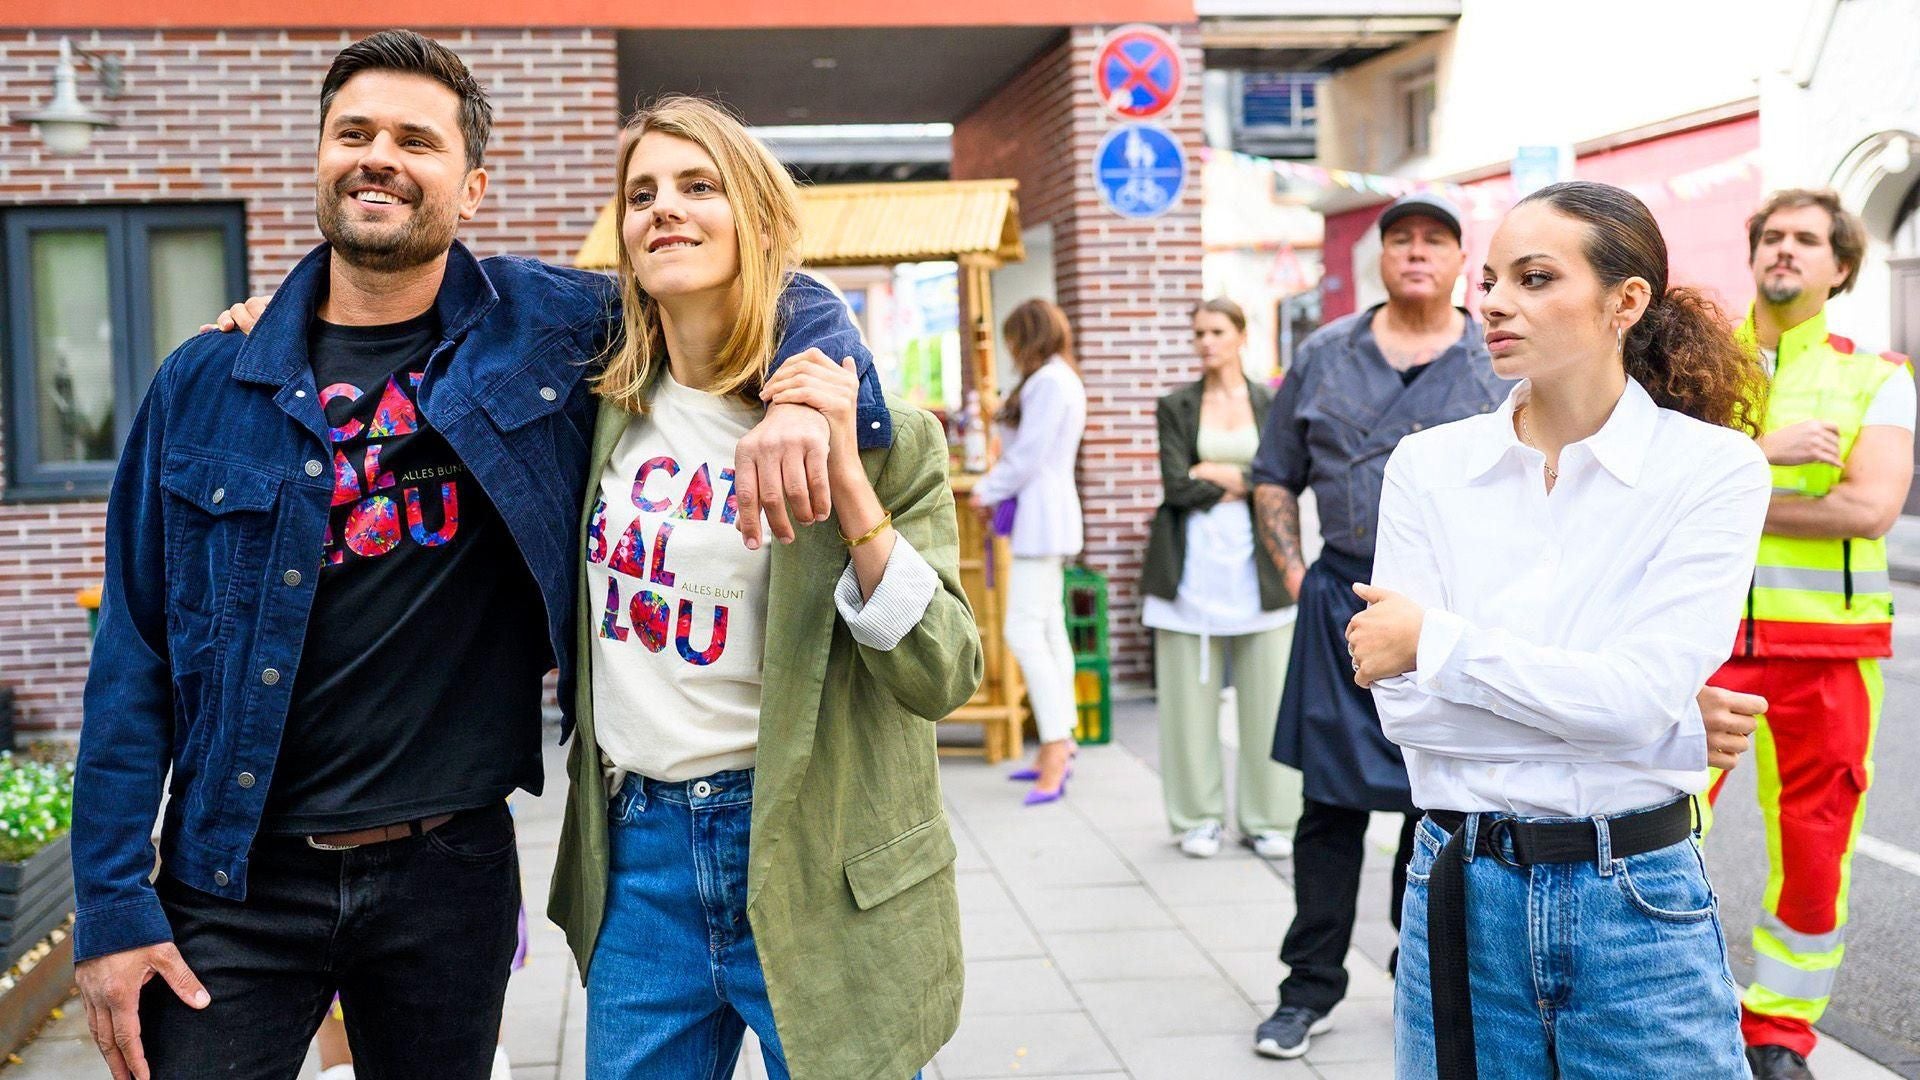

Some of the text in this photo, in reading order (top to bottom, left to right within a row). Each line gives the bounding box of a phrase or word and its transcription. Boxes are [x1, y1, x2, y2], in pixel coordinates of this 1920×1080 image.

[318, 371, 425, 442] CA
[401, 464, 468, 482] ALLES BUN
[681, 581, 745, 600] ALLES BUNT
[599, 575, 729, 666] LOU
